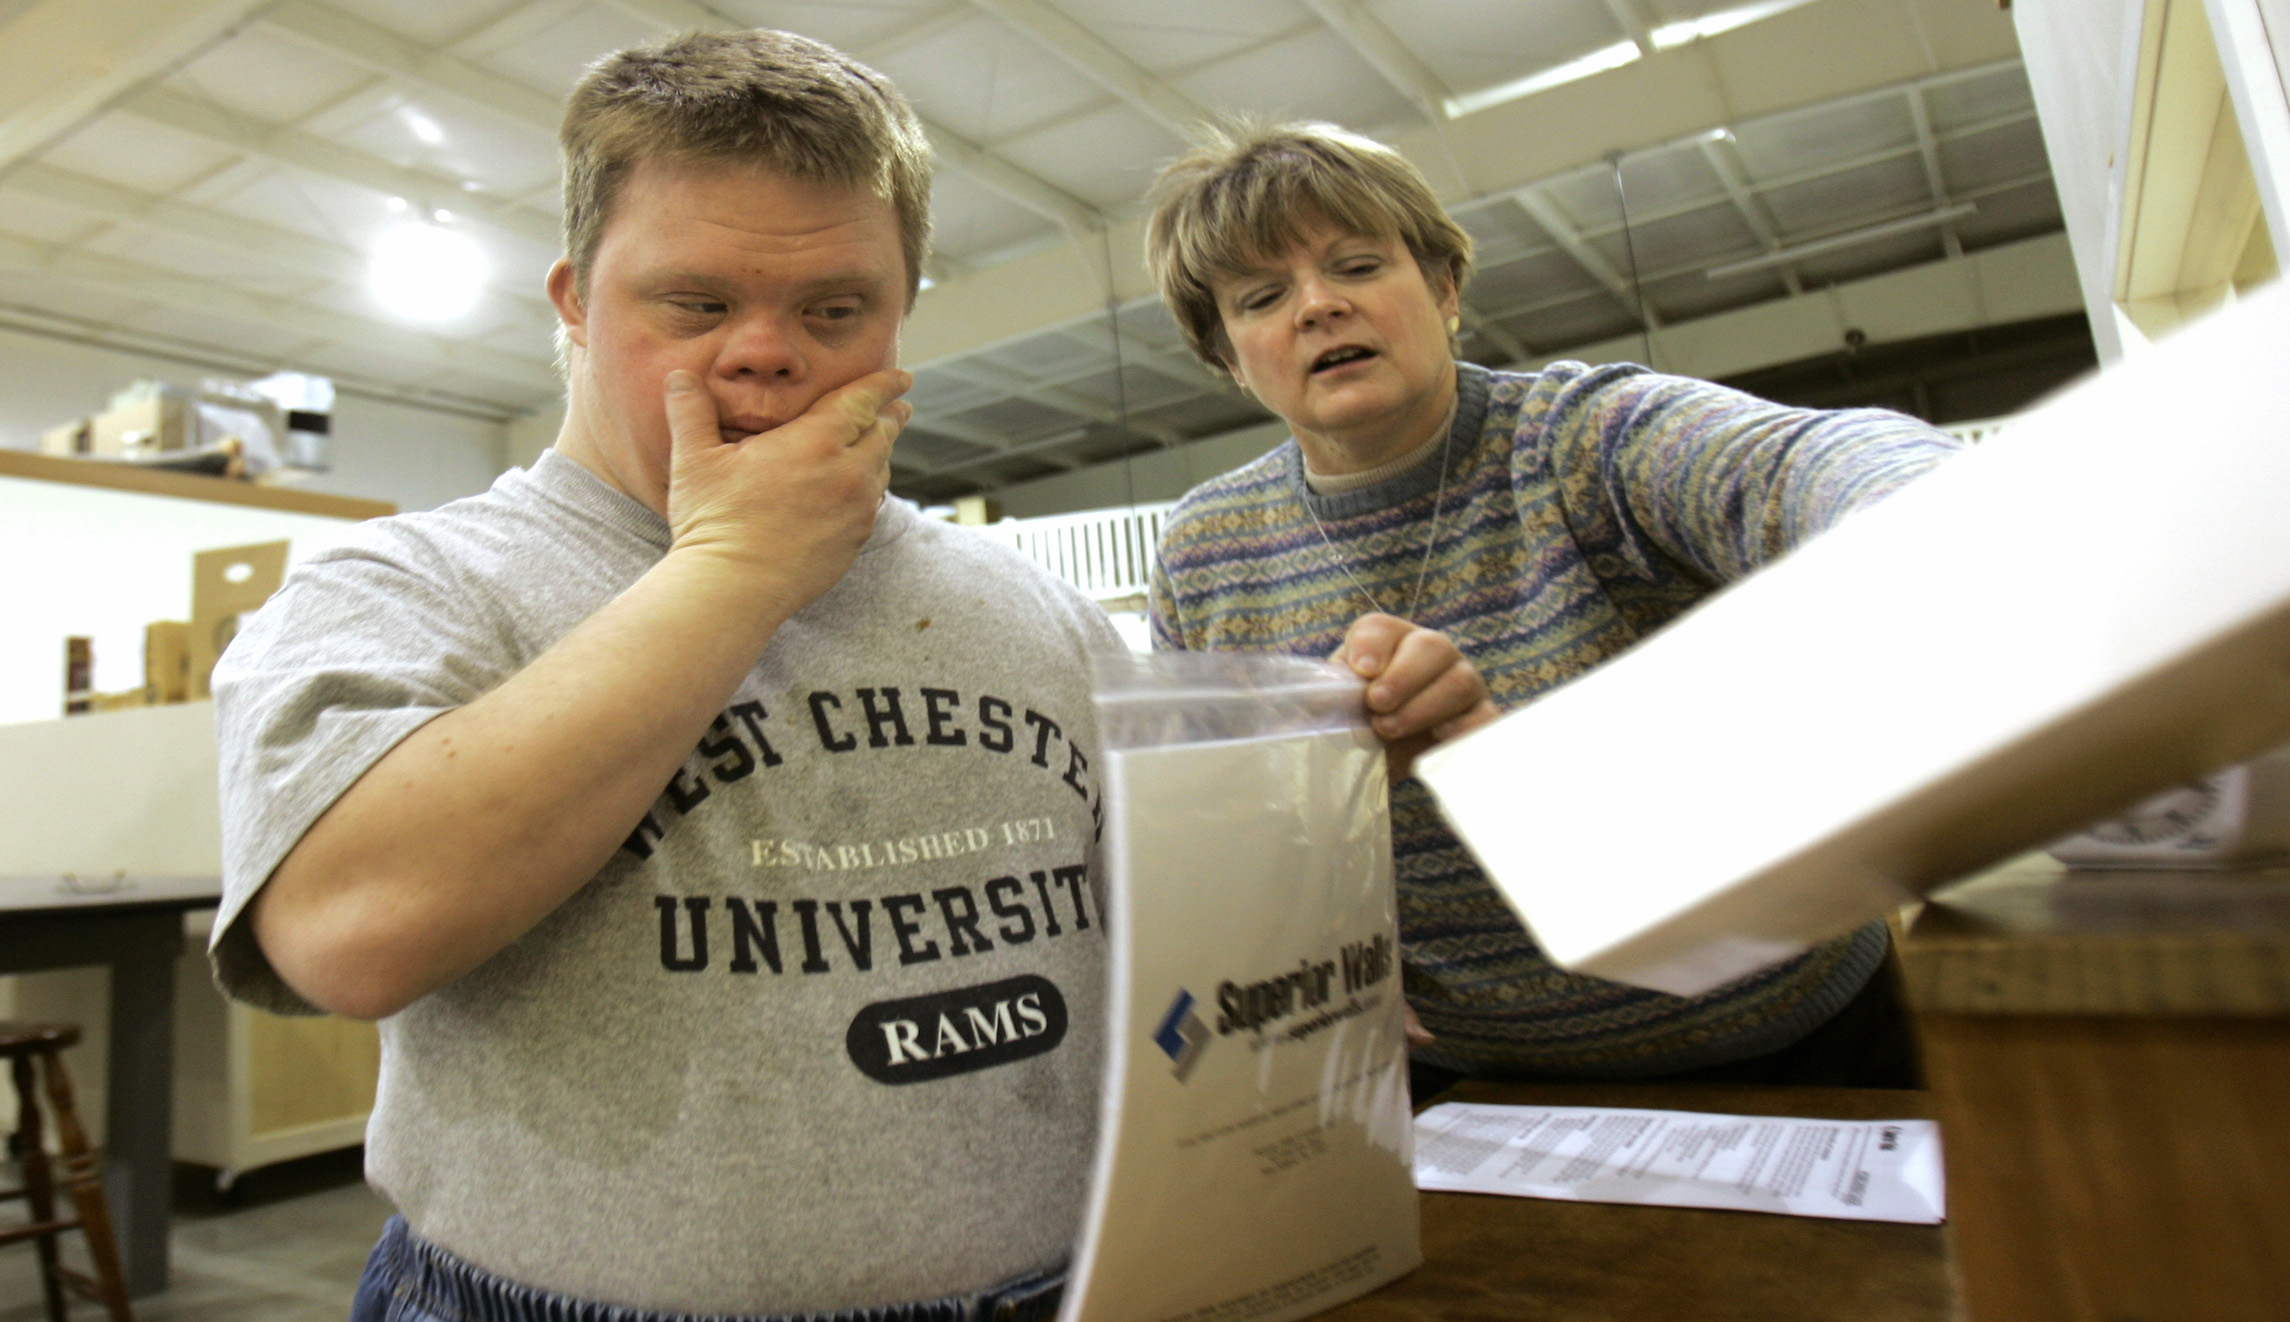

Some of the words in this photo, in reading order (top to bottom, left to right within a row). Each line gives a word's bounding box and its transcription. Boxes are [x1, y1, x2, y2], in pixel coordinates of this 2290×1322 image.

[750, 827, 990, 870] ESTABLISHED
[1002, 817, 1055, 846] 1871
[655, 863, 1107, 975] UNIVERSIT
[878, 992, 1048, 1067] RAMS
